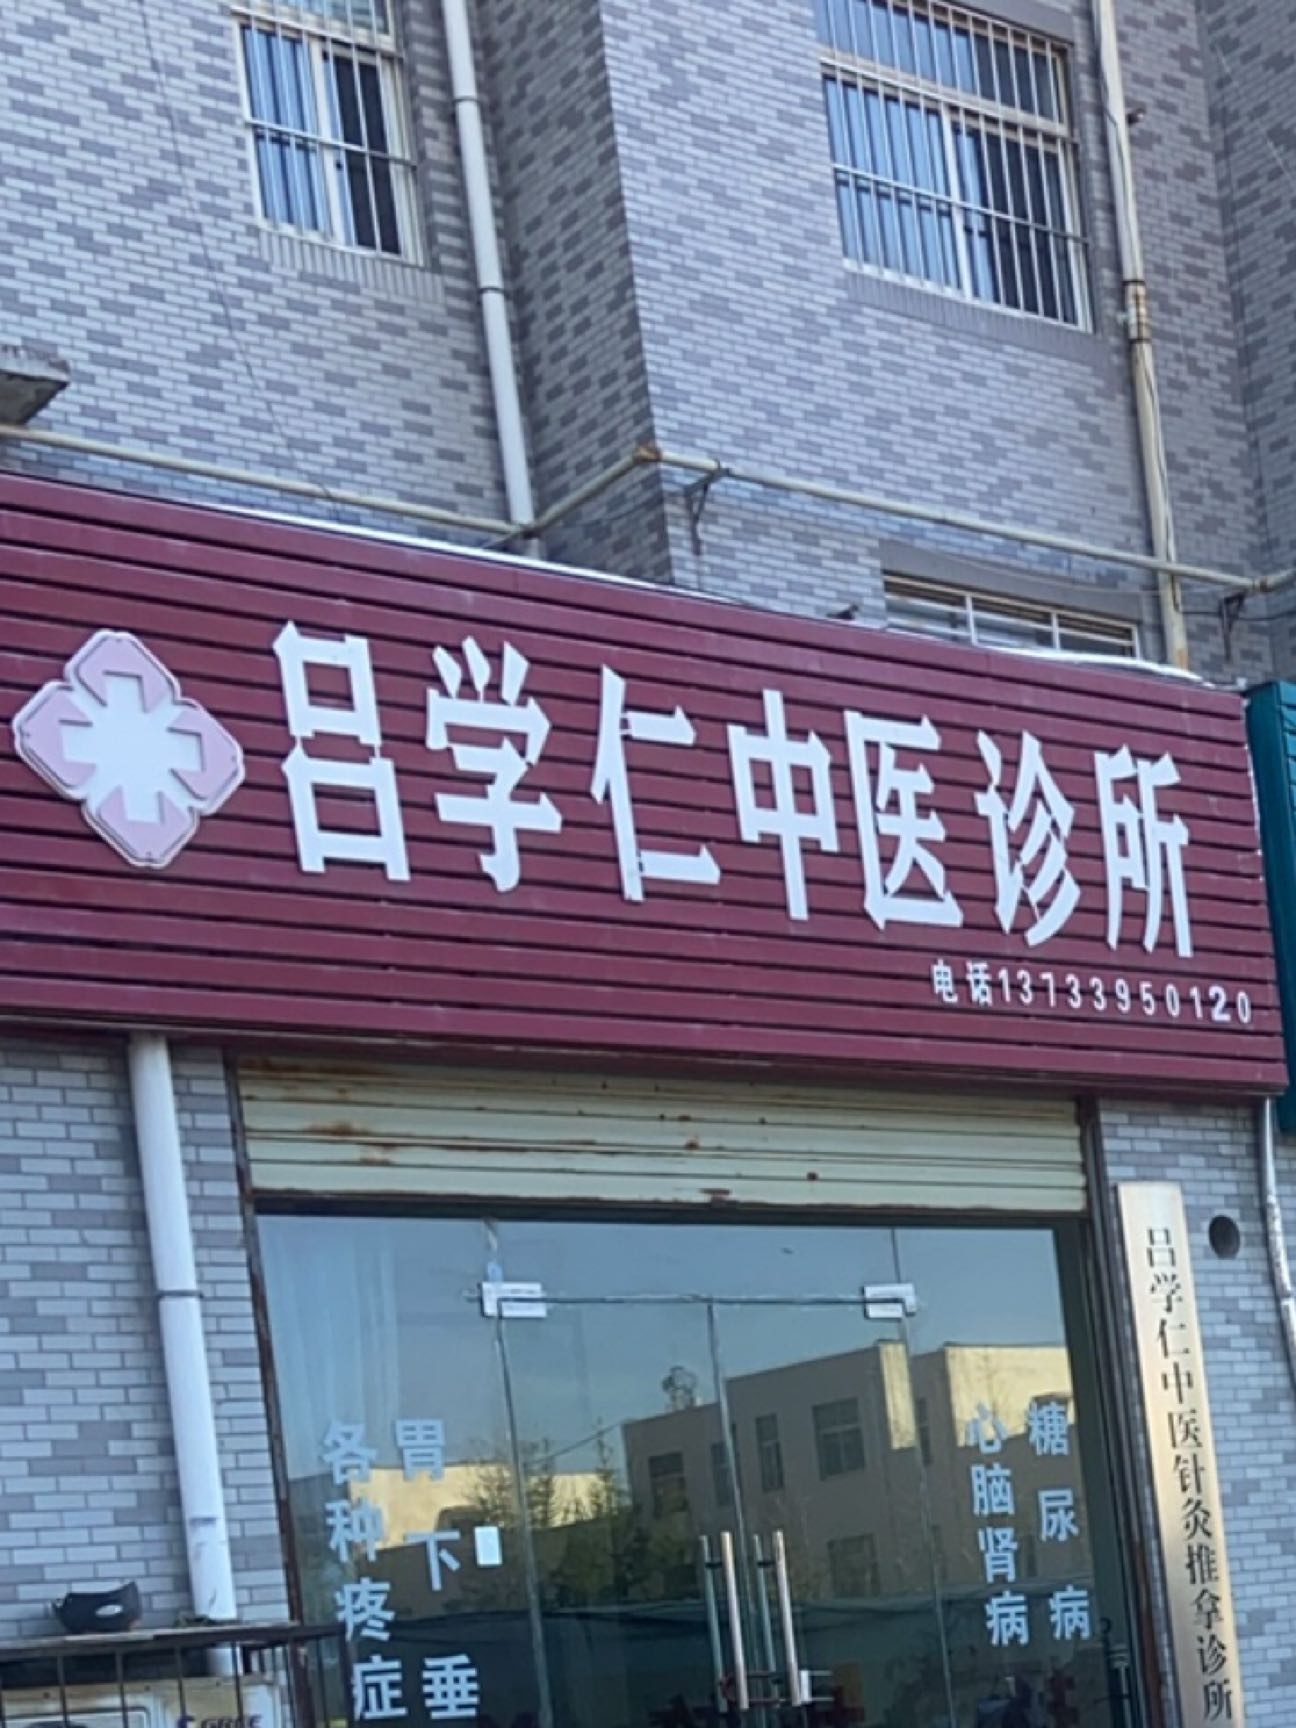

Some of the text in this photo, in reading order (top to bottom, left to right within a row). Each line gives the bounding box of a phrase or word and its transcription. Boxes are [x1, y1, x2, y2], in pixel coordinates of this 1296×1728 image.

[321, 1419, 408, 1722] 各种疼症
[395, 1418, 481, 1721] 胃下垂
[964, 1402, 1030, 1647] 心脑肾病
[1028, 1400, 1092, 1641] 糖尿病
